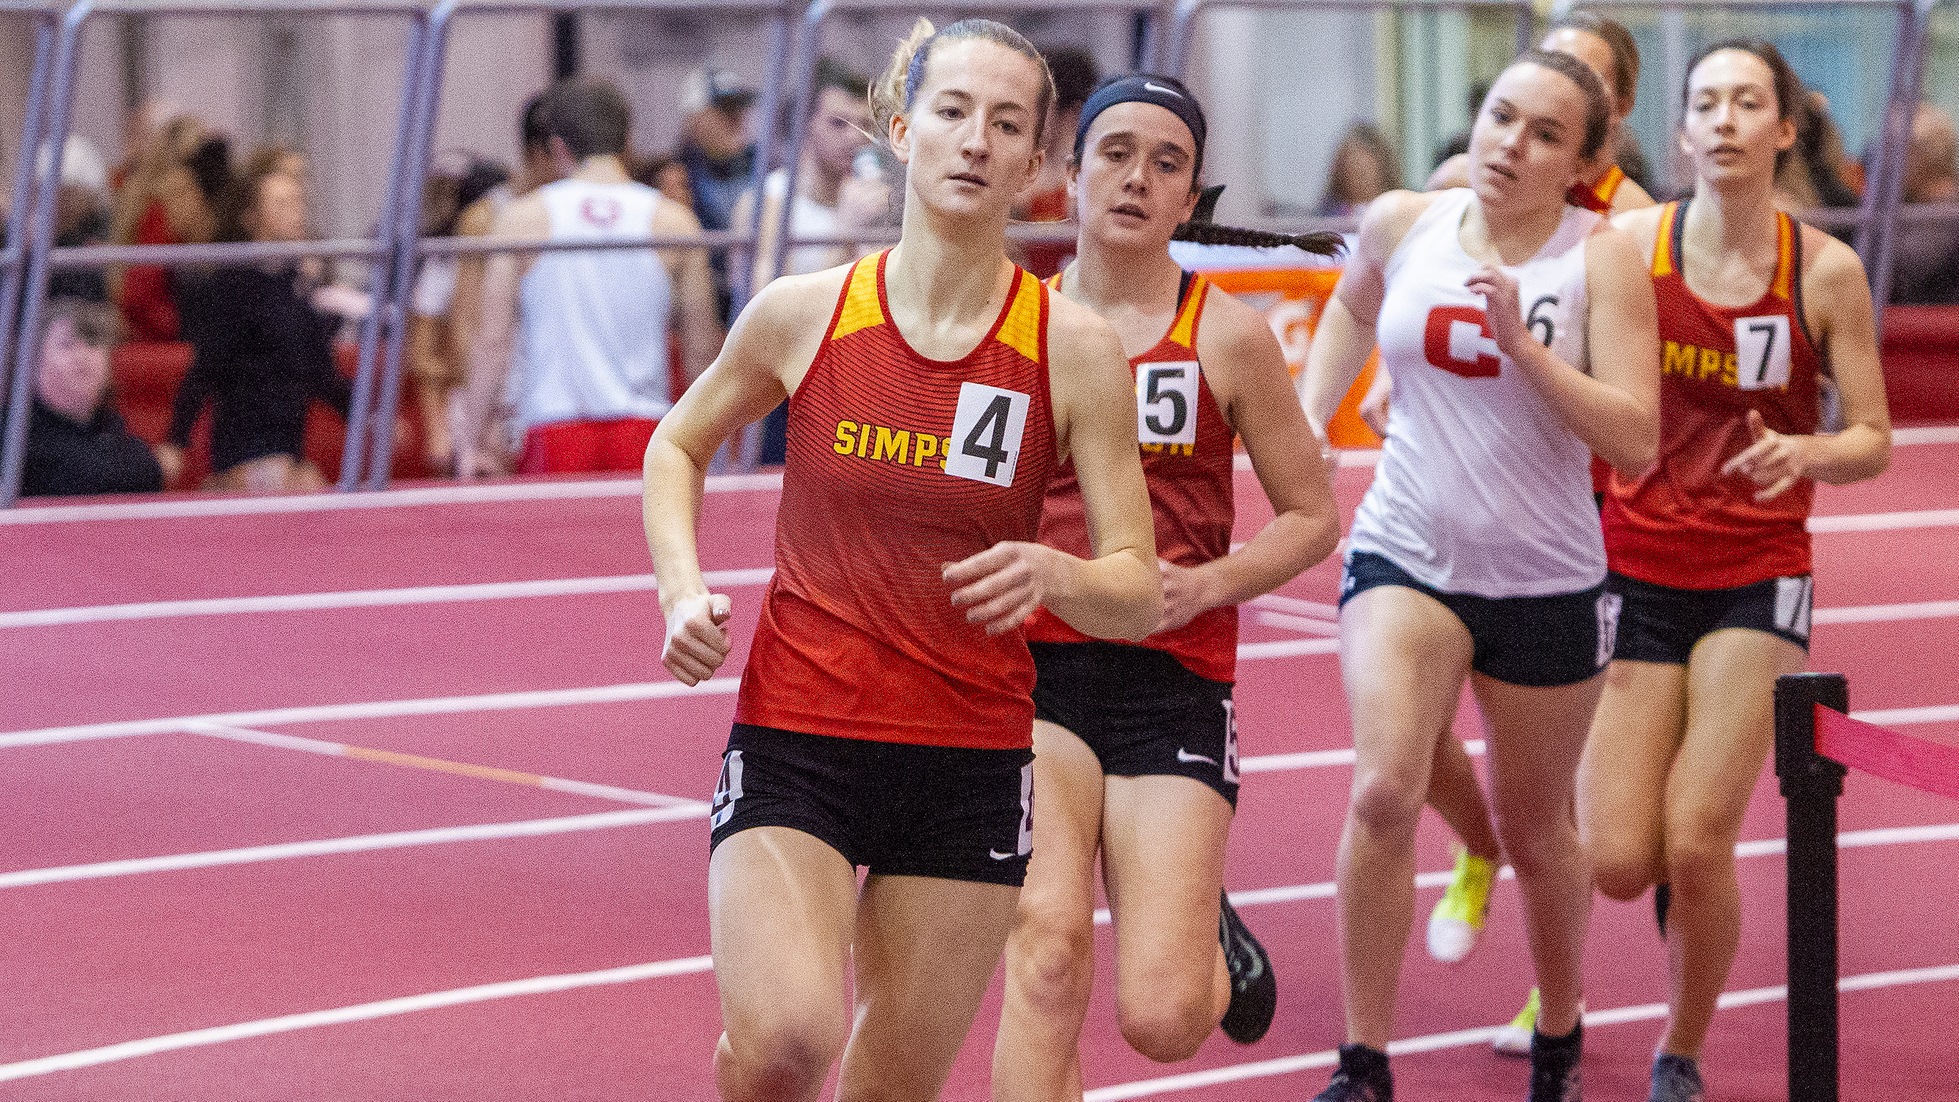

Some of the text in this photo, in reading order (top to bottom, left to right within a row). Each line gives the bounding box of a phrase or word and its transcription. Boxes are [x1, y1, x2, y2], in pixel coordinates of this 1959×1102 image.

[1425, 304, 1500, 378] C
[1526, 294, 1555, 347] 6
[1749, 322, 1777, 381] 7
[1145, 368, 1188, 436] 5
[961, 394, 1012, 479] 4
